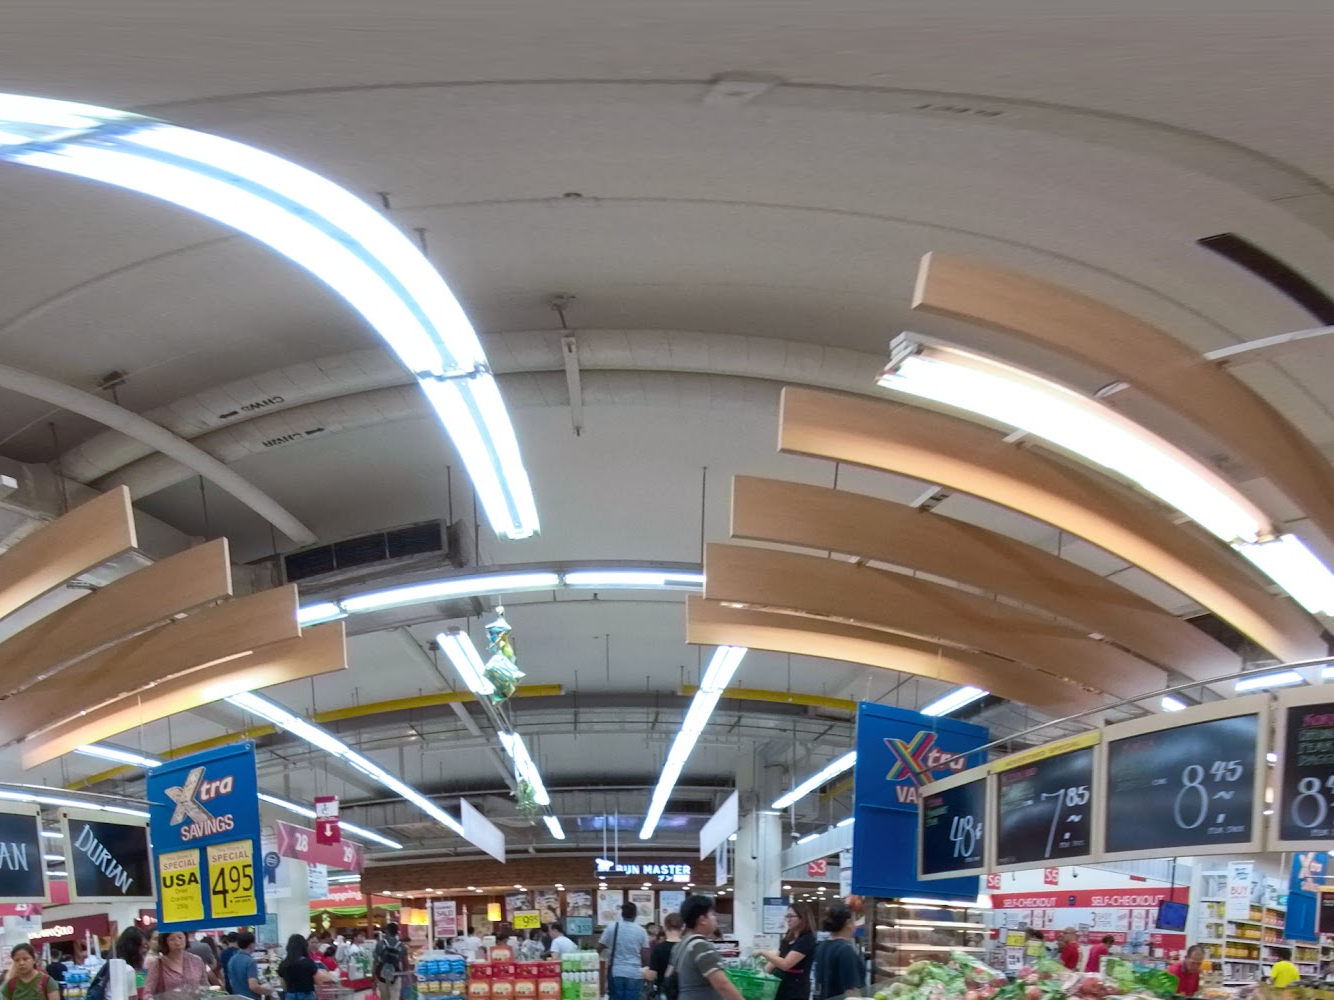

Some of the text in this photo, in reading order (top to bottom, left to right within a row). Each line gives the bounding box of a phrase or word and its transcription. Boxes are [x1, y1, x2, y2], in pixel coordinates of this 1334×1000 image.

[884, 731, 965, 787] Xtra
[165, 766, 234, 827] Xtra
[180, 814, 235, 842] SAVINGS
[295, 832, 309, 853] 28
[75, 824, 134, 895] DURIAN
[211, 850, 250, 863] SPECIAL
[163, 859, 197, 871] SPECIAL
[642, 864, 692, 875] MASTER
[808, 859, 827, 873] S3
[162, 872, 200, 889] USA
[987, 875, 1001, 888] S6
[1045, 867, 1059, 882] S5
[1230, 885, 1248, 896] BUY
[1003, 896, 1058, 908] SELF-CHECKOUT
[1090, 894, 1165, 908] SELF-CHECKOUT
